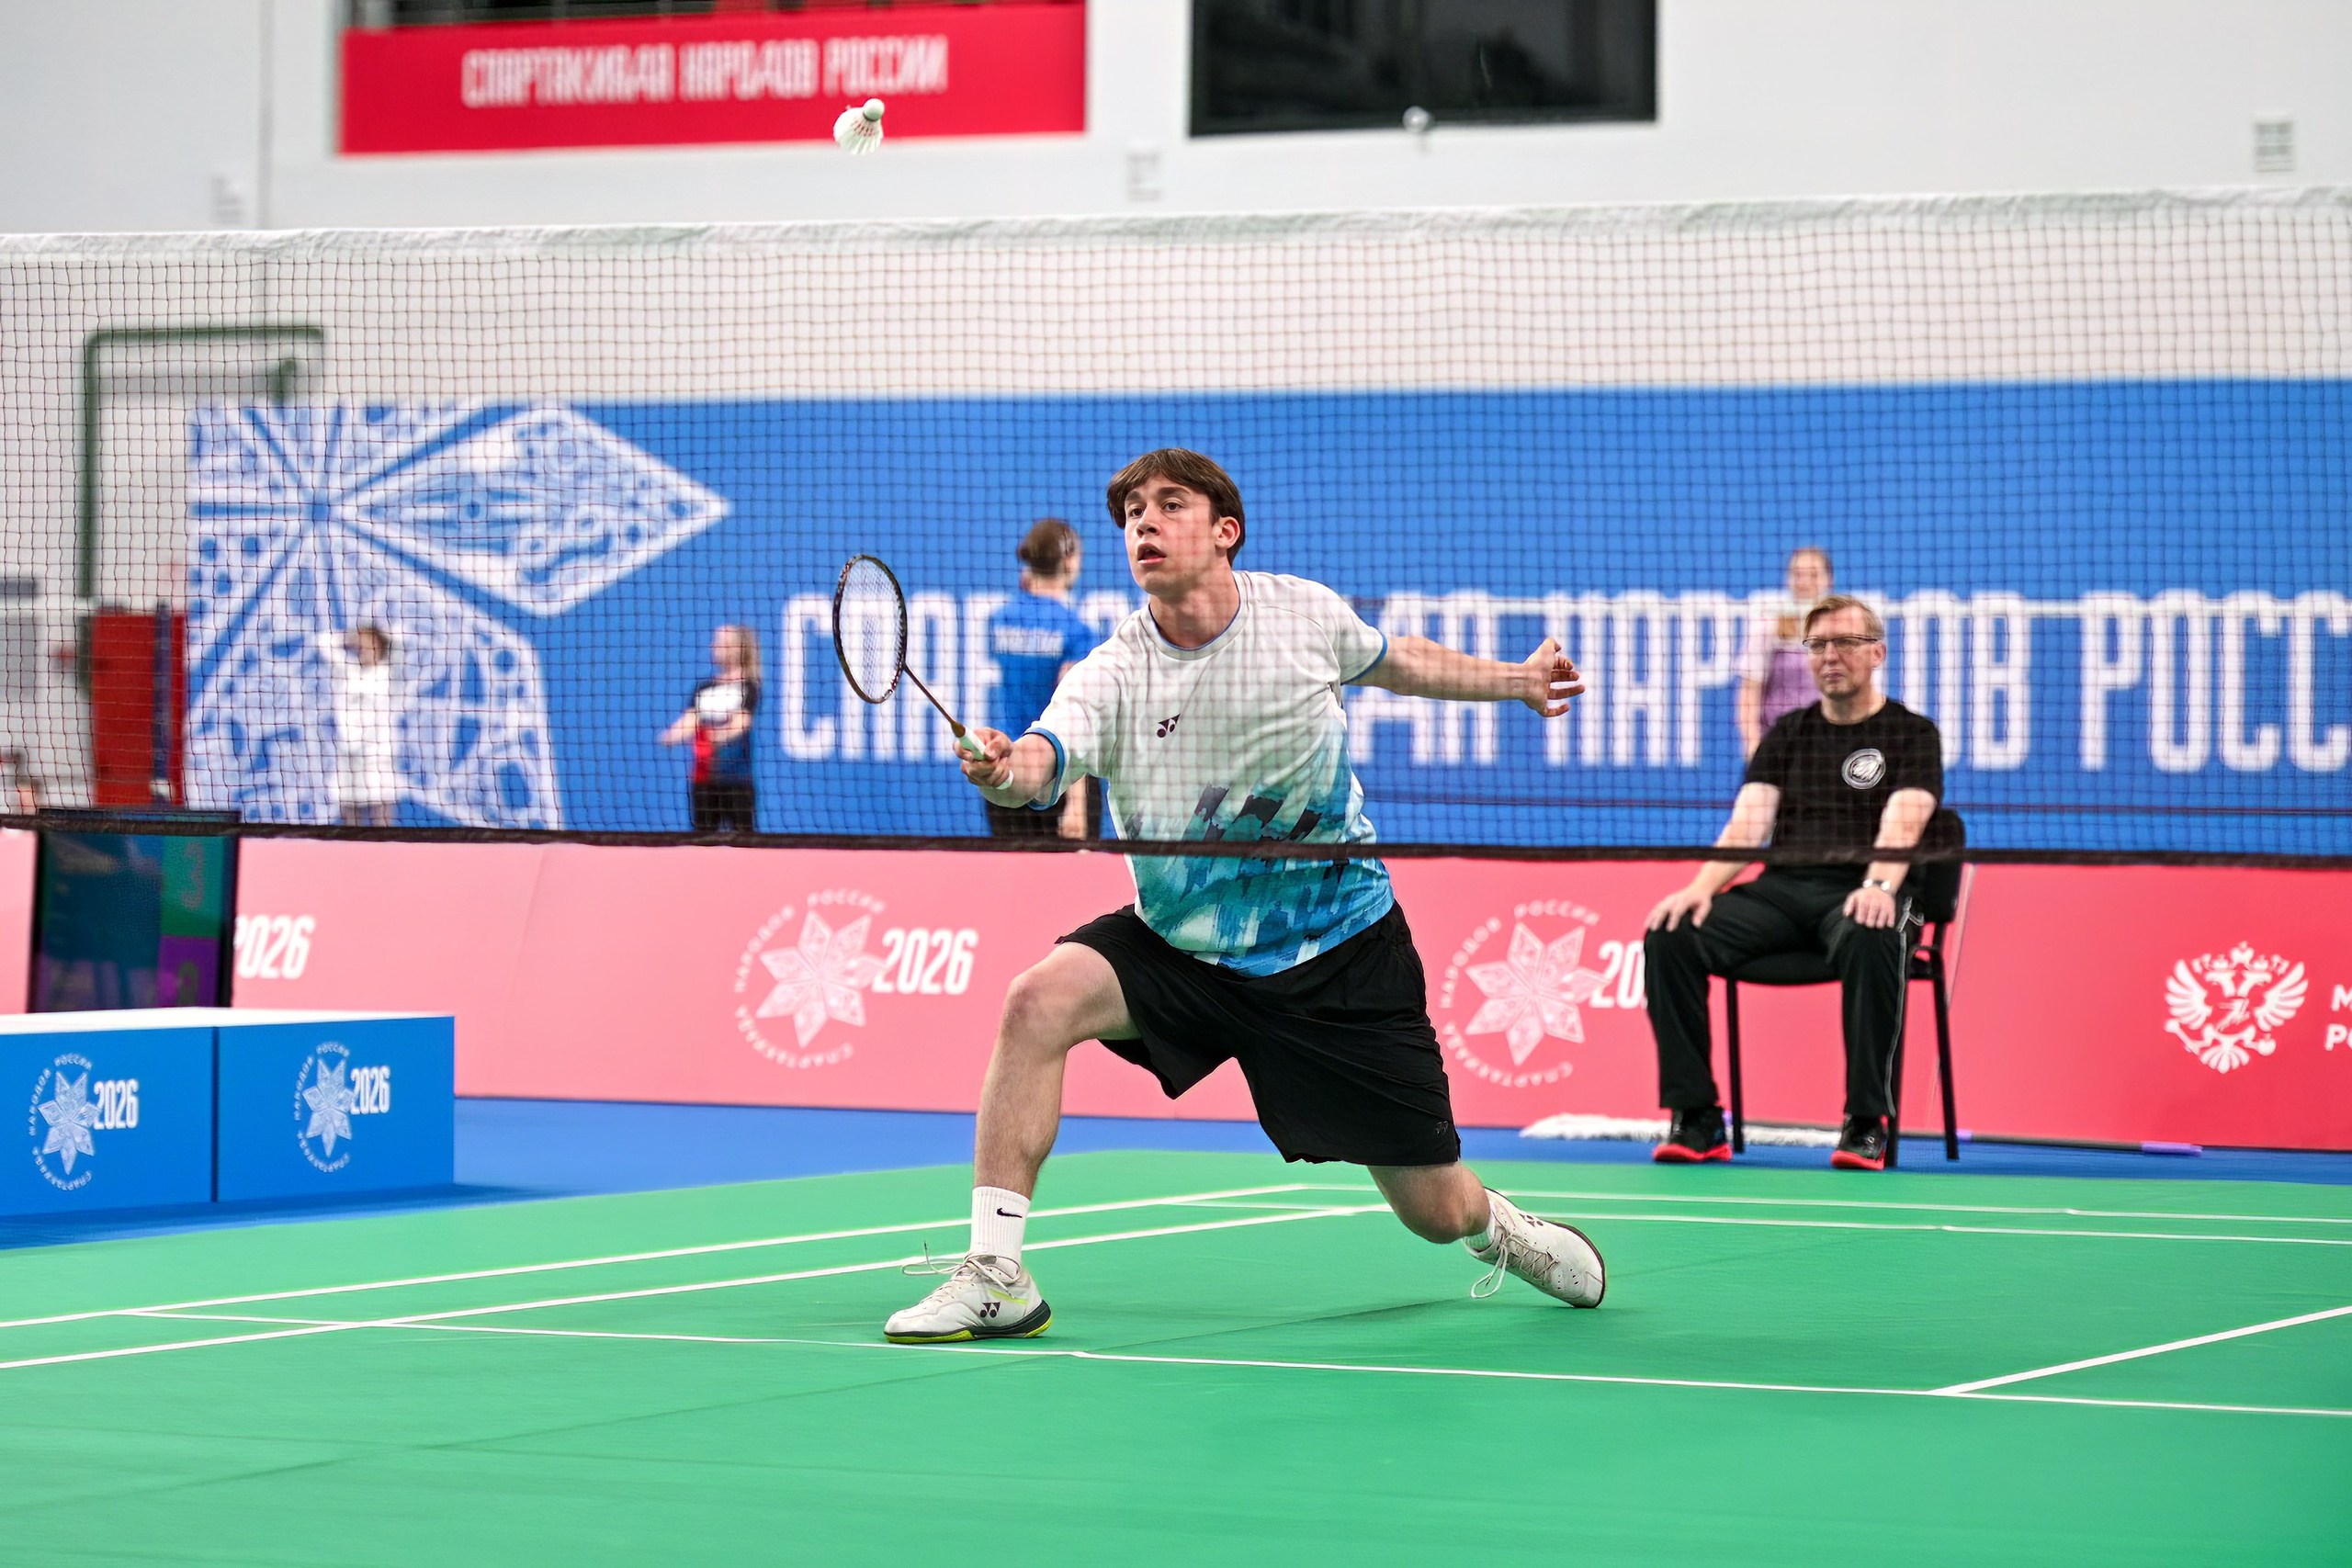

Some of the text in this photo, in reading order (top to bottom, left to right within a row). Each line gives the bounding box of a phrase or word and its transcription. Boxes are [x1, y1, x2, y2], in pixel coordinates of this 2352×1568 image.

[1544, 589, 2030, 771] НАРОВ
[871, 928, 979, 995] 2026
[2324, 1022, 2352, 1051] Р
[93, 1078, 140, 1130] 2026
[350, 1066, 390, 1115] 2026
